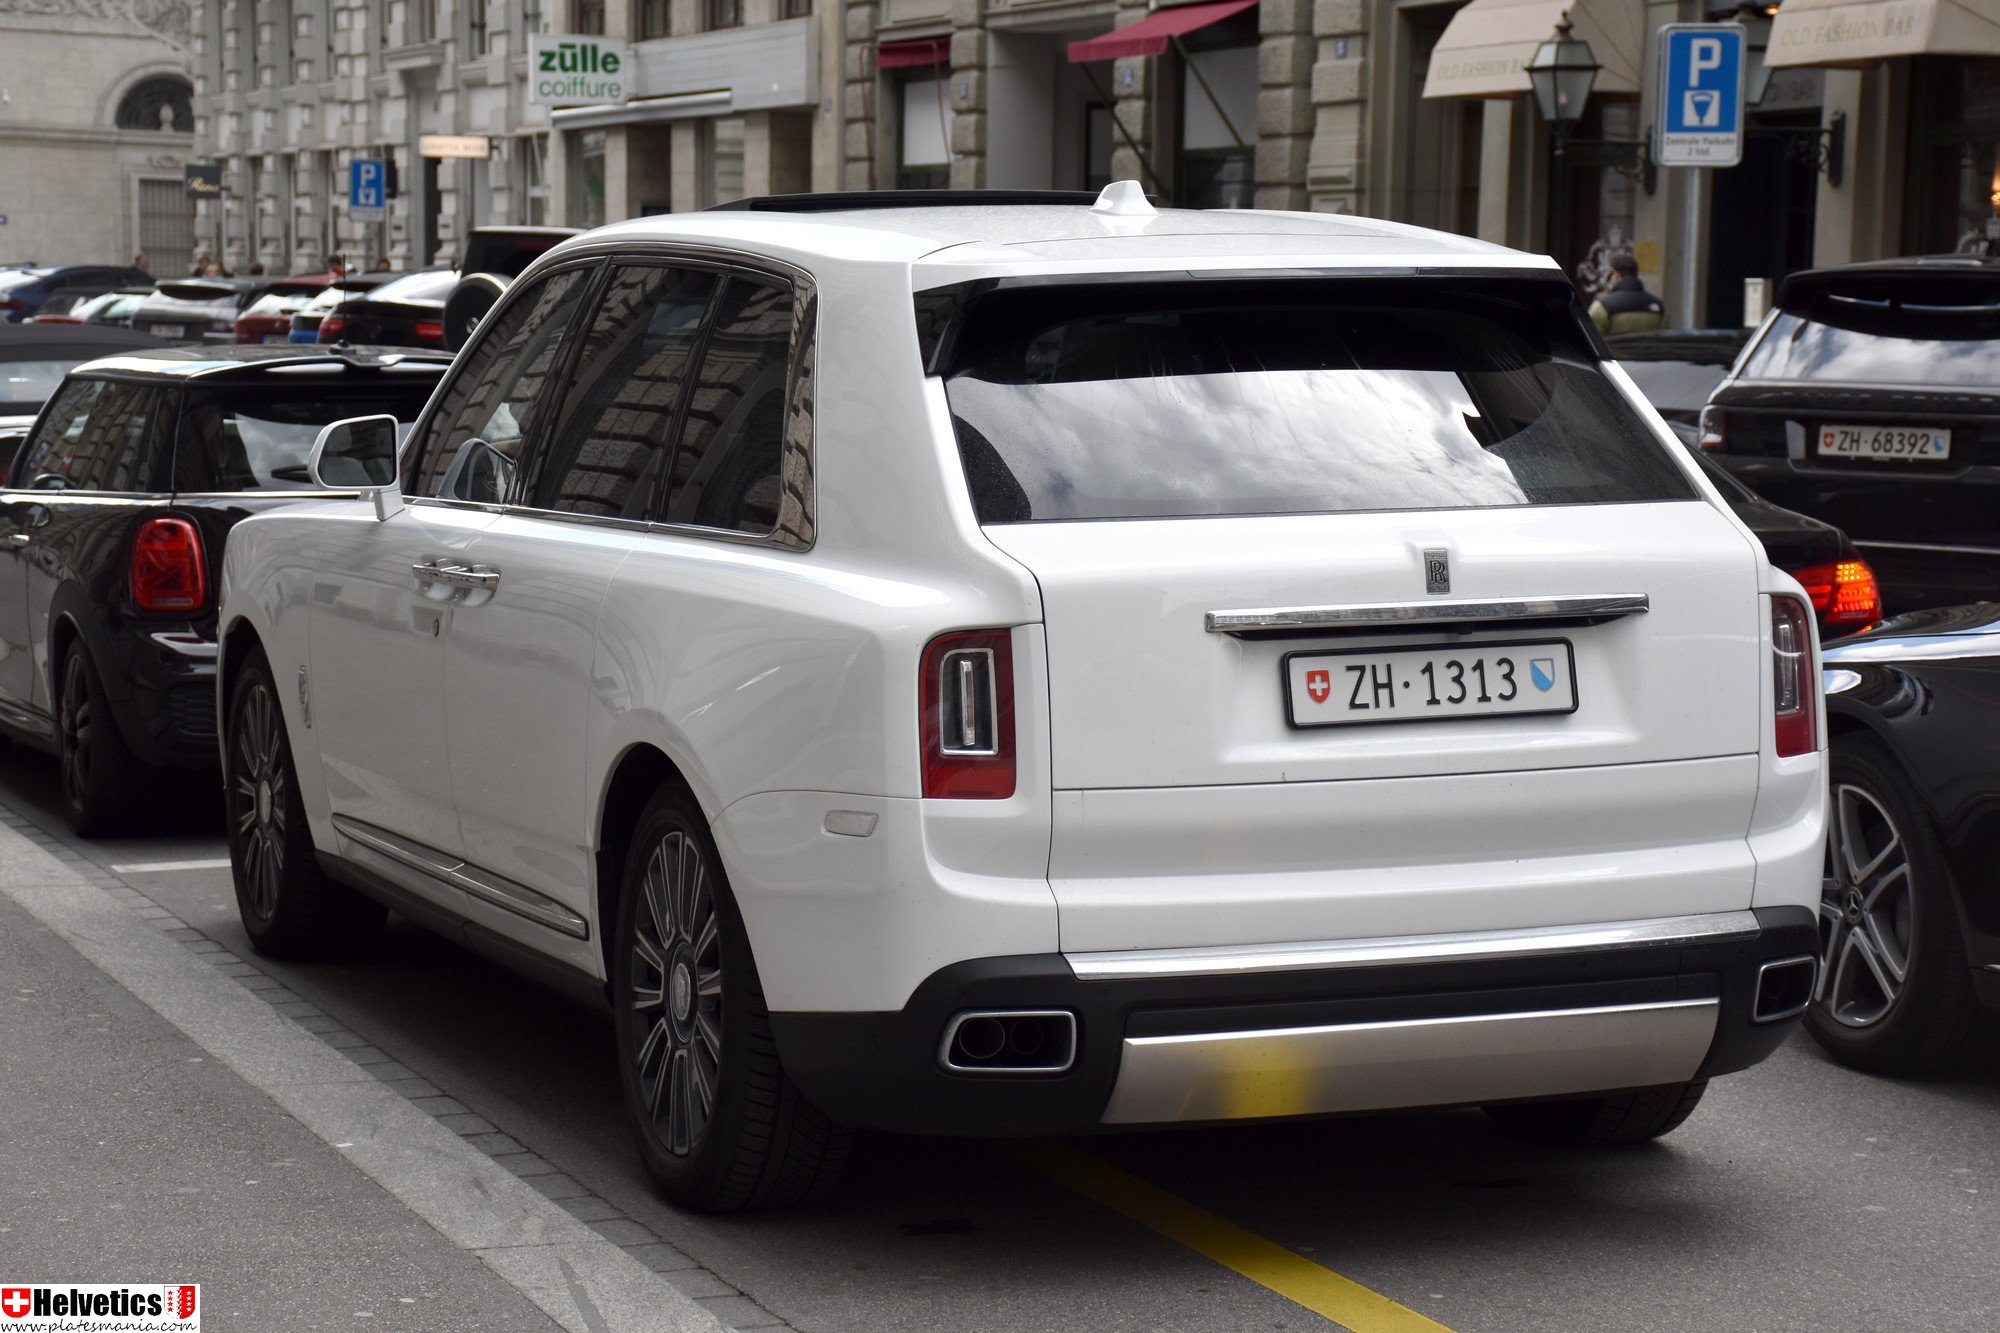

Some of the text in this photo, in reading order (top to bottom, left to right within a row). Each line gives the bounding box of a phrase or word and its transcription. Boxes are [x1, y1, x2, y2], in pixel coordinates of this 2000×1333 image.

[1781, 15, 1915, 47] OLD FASHION BAR
[1436, 63, 1459, 81] OLD
[1689, 37, 1722, 88] P
[538, 76, 622, 98] coiffure
[360, 163, 376, 187] P
